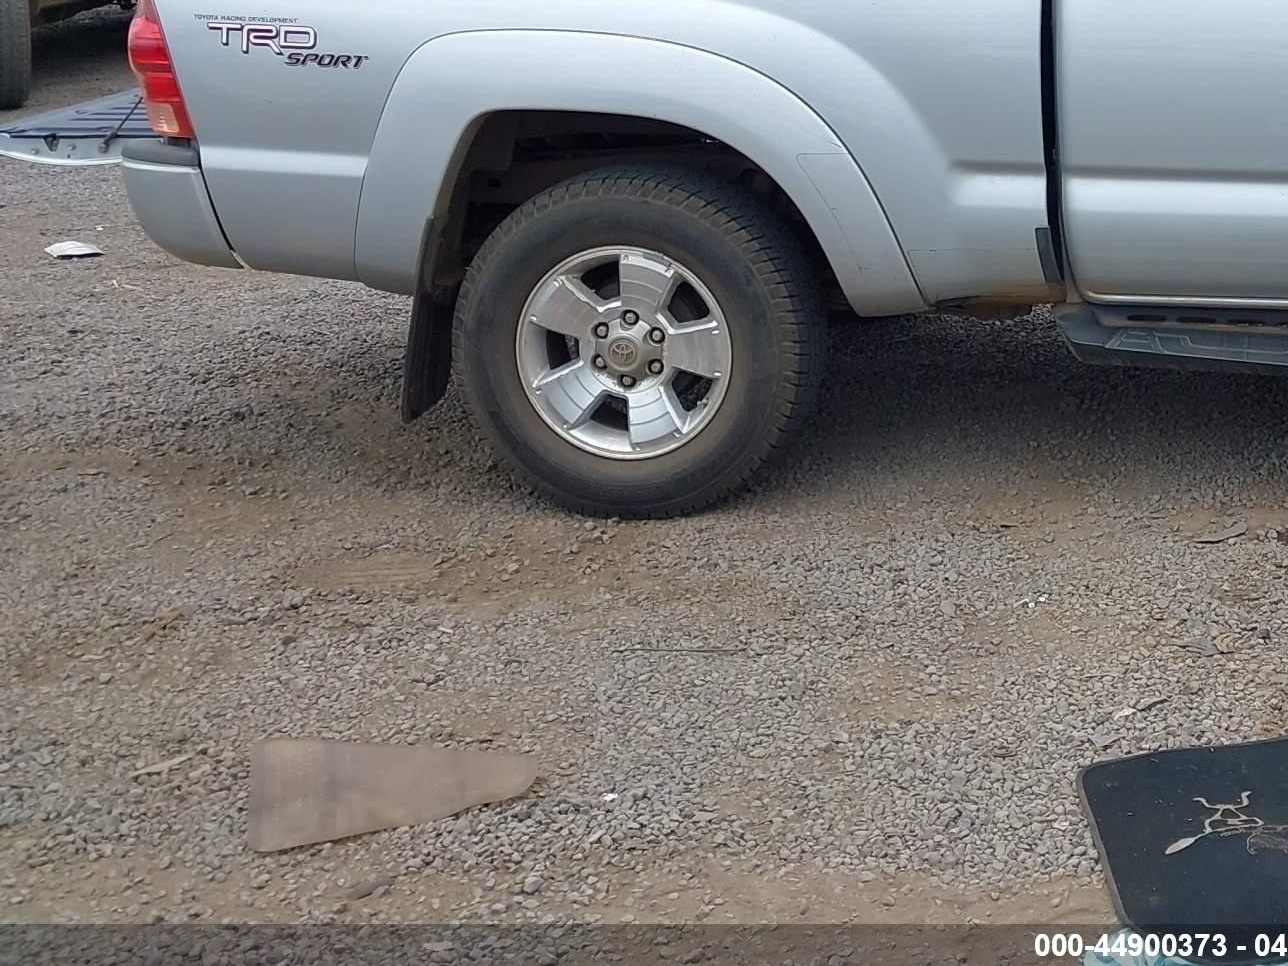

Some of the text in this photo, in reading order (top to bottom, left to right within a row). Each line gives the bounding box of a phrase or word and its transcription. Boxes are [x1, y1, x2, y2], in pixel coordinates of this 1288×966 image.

[248, 16, 298, 24] DEVELOPMENT
[207, 22, 317, 55] TRD
[284, 52, 366, 69] SPORT
